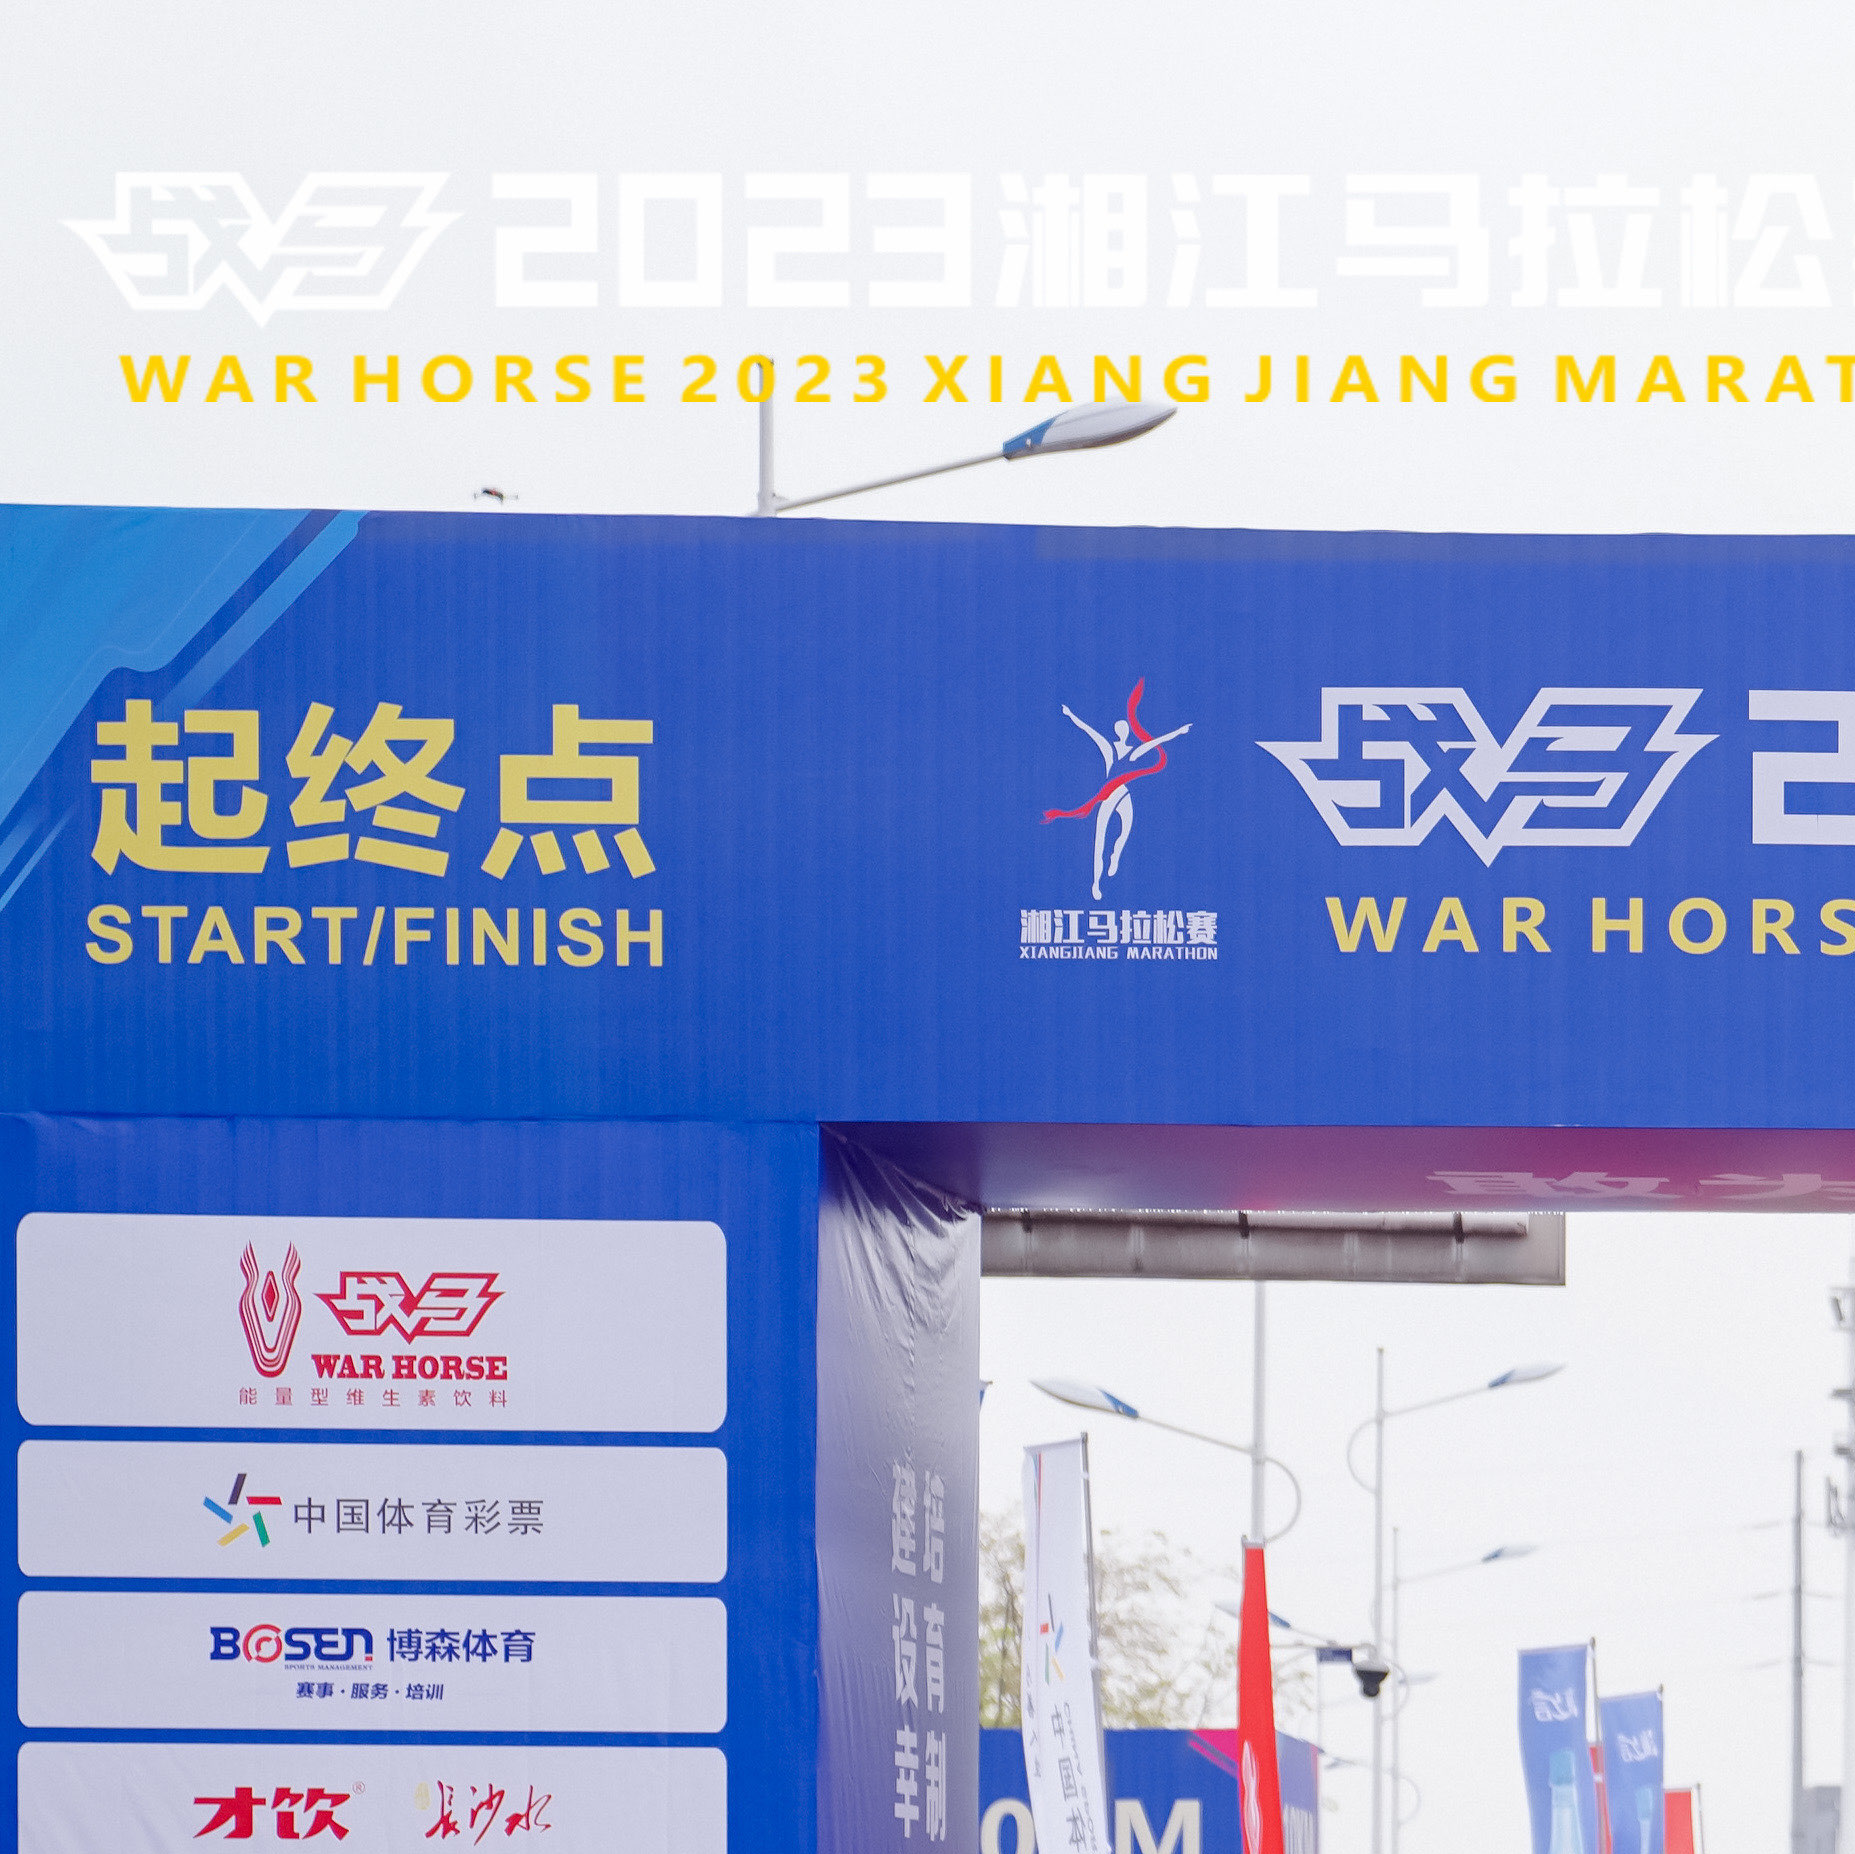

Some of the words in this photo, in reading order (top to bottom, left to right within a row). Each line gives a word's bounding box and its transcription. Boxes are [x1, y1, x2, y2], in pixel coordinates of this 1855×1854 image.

[90, 698, 656, 881] 起终点
[86, 905, 664, 968] START/FINISH
[1020, 909, 1218, 945] 湘江马拉松赛
[1325, 896, 1552, 955] WAR
[1019, 946, 1119, 960] XIANGJIANG
[1126, 946, 1218, 961] MARATHON
[311, 1354, 384, 1380] WAR
[392, 1354, 509, 1381] HORSE
[238, 1387, 509, 1408] 能量型维生素饮料
[293, 1497, 545, 1537] 中国体育彩票
[210, 1624, 374, 1663] BOSEN
[387, 1628, 536, 1664] 博森体育
[193, 1786, 352, 1841] 才饮
